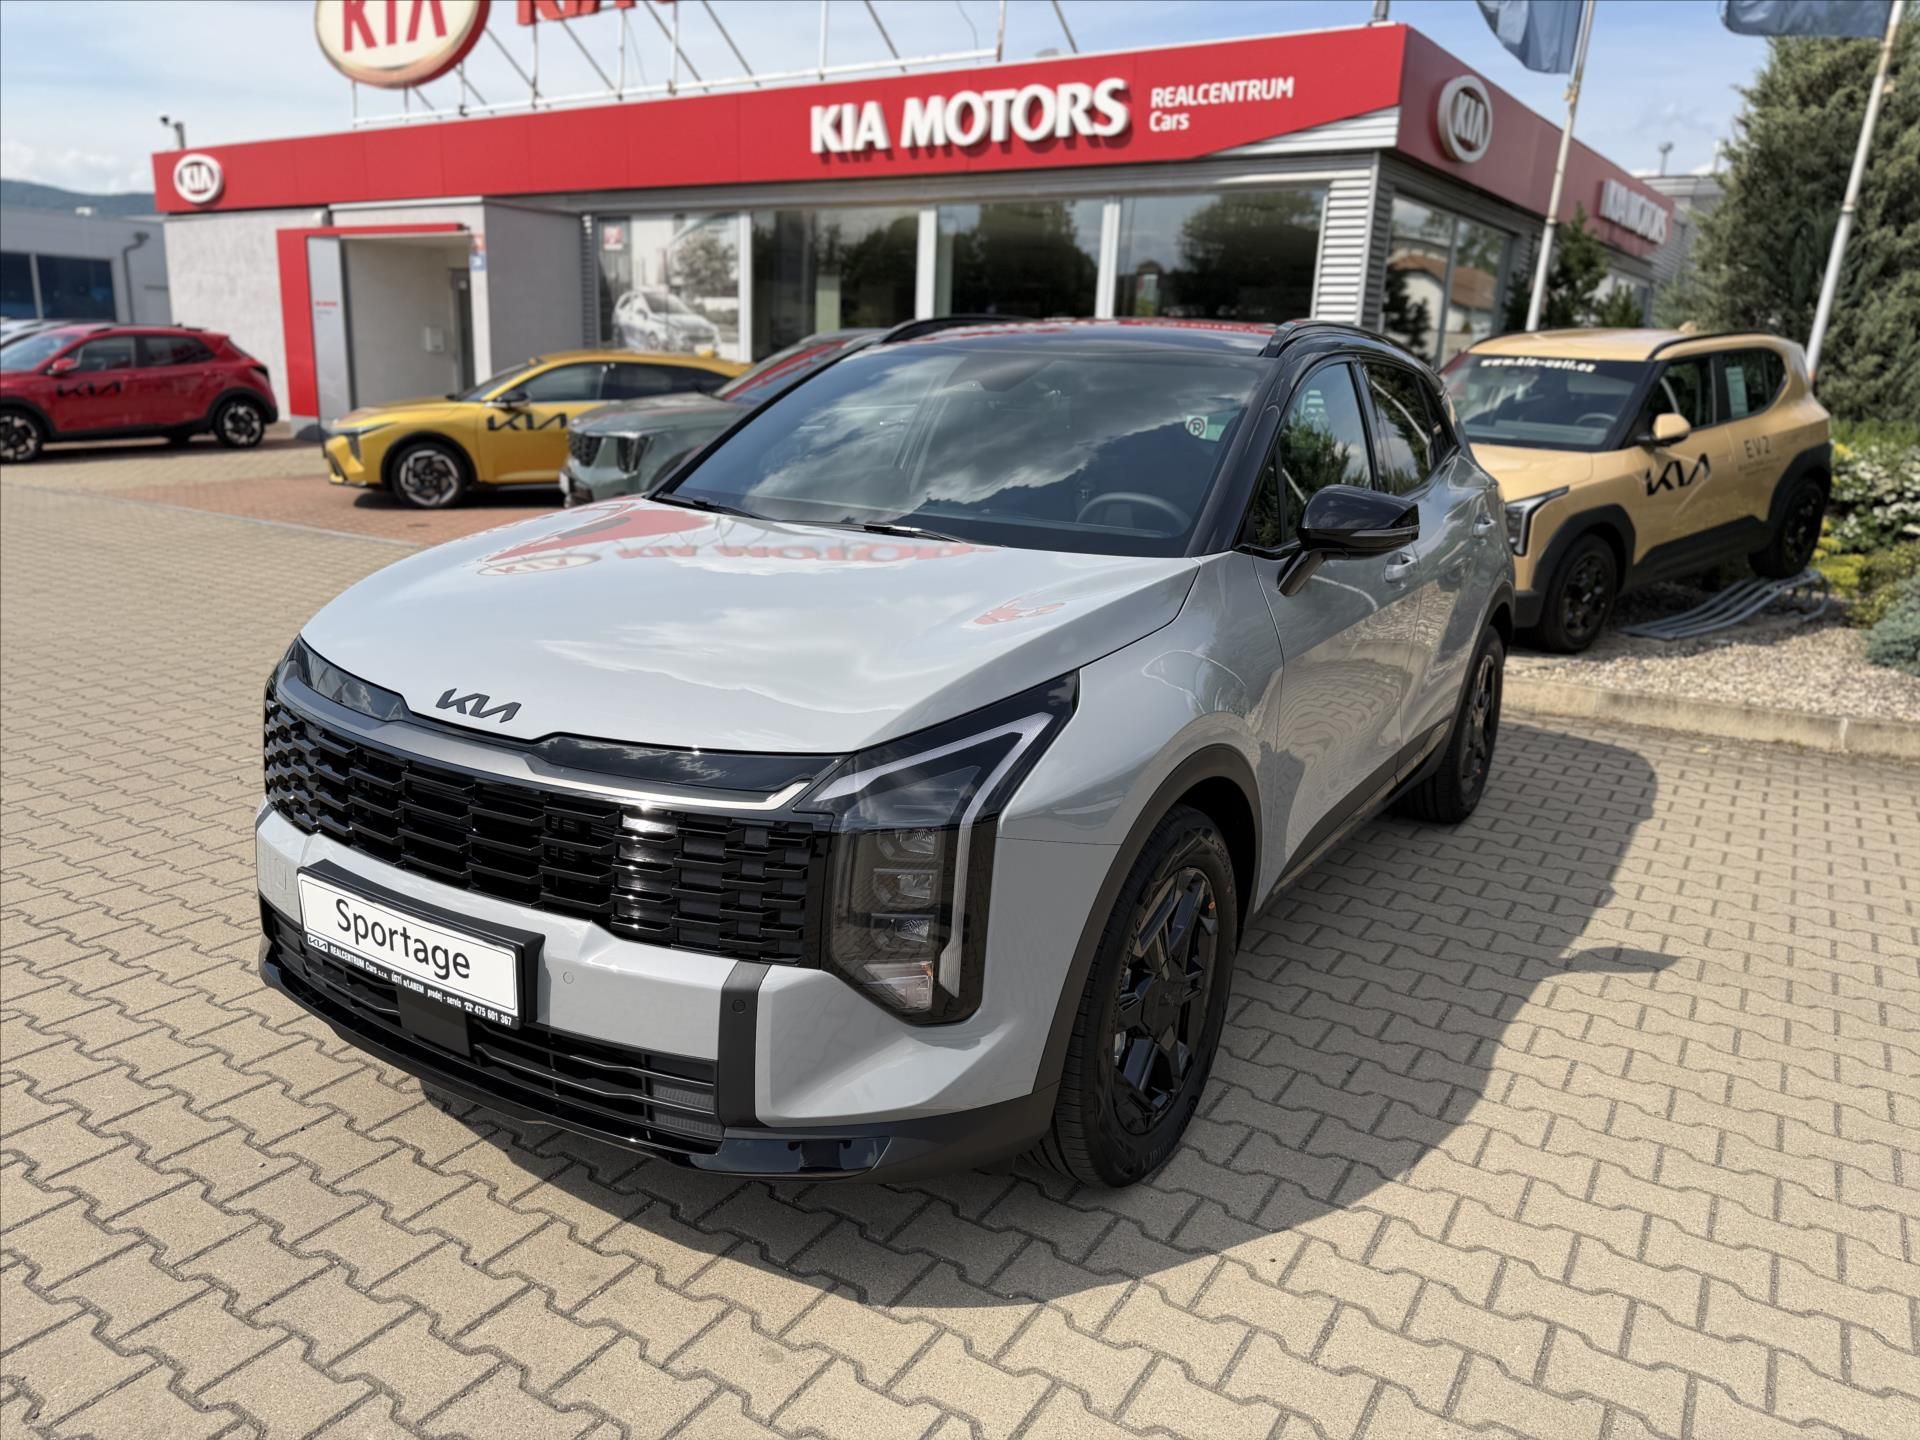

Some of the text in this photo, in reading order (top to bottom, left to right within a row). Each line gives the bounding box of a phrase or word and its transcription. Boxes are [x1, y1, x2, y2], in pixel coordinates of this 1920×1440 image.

[1150, 76, 1295, 109] REALCENTRUM
[810, 78, 1128, 154] KIA MOTORS
[1149, 112, 1189, 132] Cars
[1455, 91, 1485, 147] KIA
[181, 166, 211, 193] KIA
[1645, 453, 1711, 496] KIA
[435, 687, 522, 723] KIA
[336, 898, 470, 980] Sportage
[330, 945, 365, 969] REALCENTRUM
[365, 961, 377, 974] Cars
[427, 988, 442, 1003] prodej
[447, 995, 462, 1008] servis
[474, 1005, 486, 1017] 475
[487, 1010, 498, 1022] 601
[500, 1014, 512, 1026] 367
